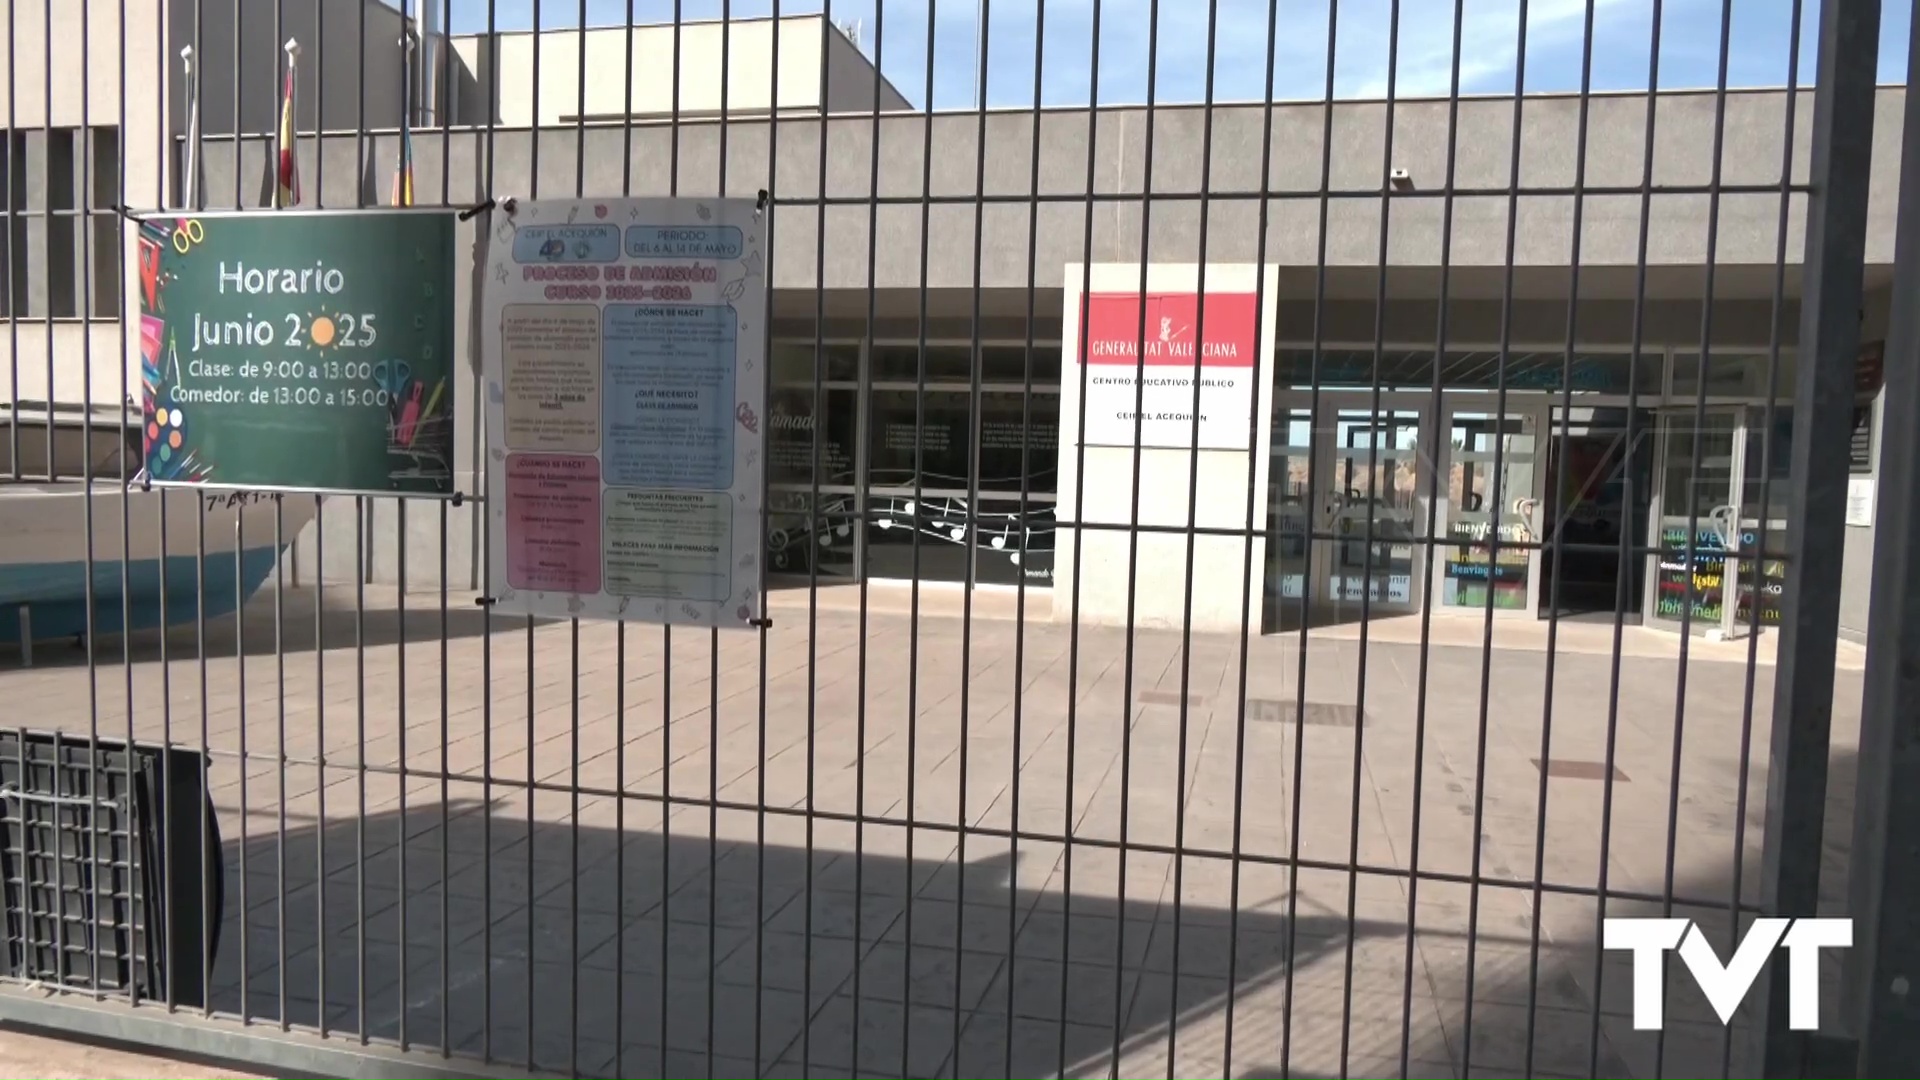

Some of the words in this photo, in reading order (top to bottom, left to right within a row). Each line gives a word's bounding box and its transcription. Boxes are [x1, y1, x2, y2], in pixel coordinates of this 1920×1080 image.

[634, 243, 650, 254] DEL
[663, 243, 673, 253] AL
[689, 243, 701, 254] DE
[705, 243, 737, 255] MAYO
[219, 260, 344, 294] Horario
[523, 266, 600, 282] PROCESO
[603, 266, 626, 282] DE
[629, 262, 717, 282] ADMISIÓN
[544, 285, 602, 301] CURSO
[192, 313, 274, 352] Junio
[1092, 341, 1162, 356] GENERALTAT
[1168, 341, 1237, 358] VALECIANA
[189, 359, 234, 377] Clase:
[239, 360, 259, 377] de
[263, 361, 304, 379] 9:00
[309, 366, 318, 379] a
[323, 361, 371, 380] 13:00
[1092, 377, 1131, 386] CENTRO
[170, 385, 244, 403] Comedor:
[249, 386, 268, 403] de
[273, 387, 321, 405] 13:00
[325, 392, 334, 405] a
[340, 388, 389, 406] 15:00
[1155, 412, 1207, 422] ACEQUIN
[1451, 563, 1504, 578] Benvingts
